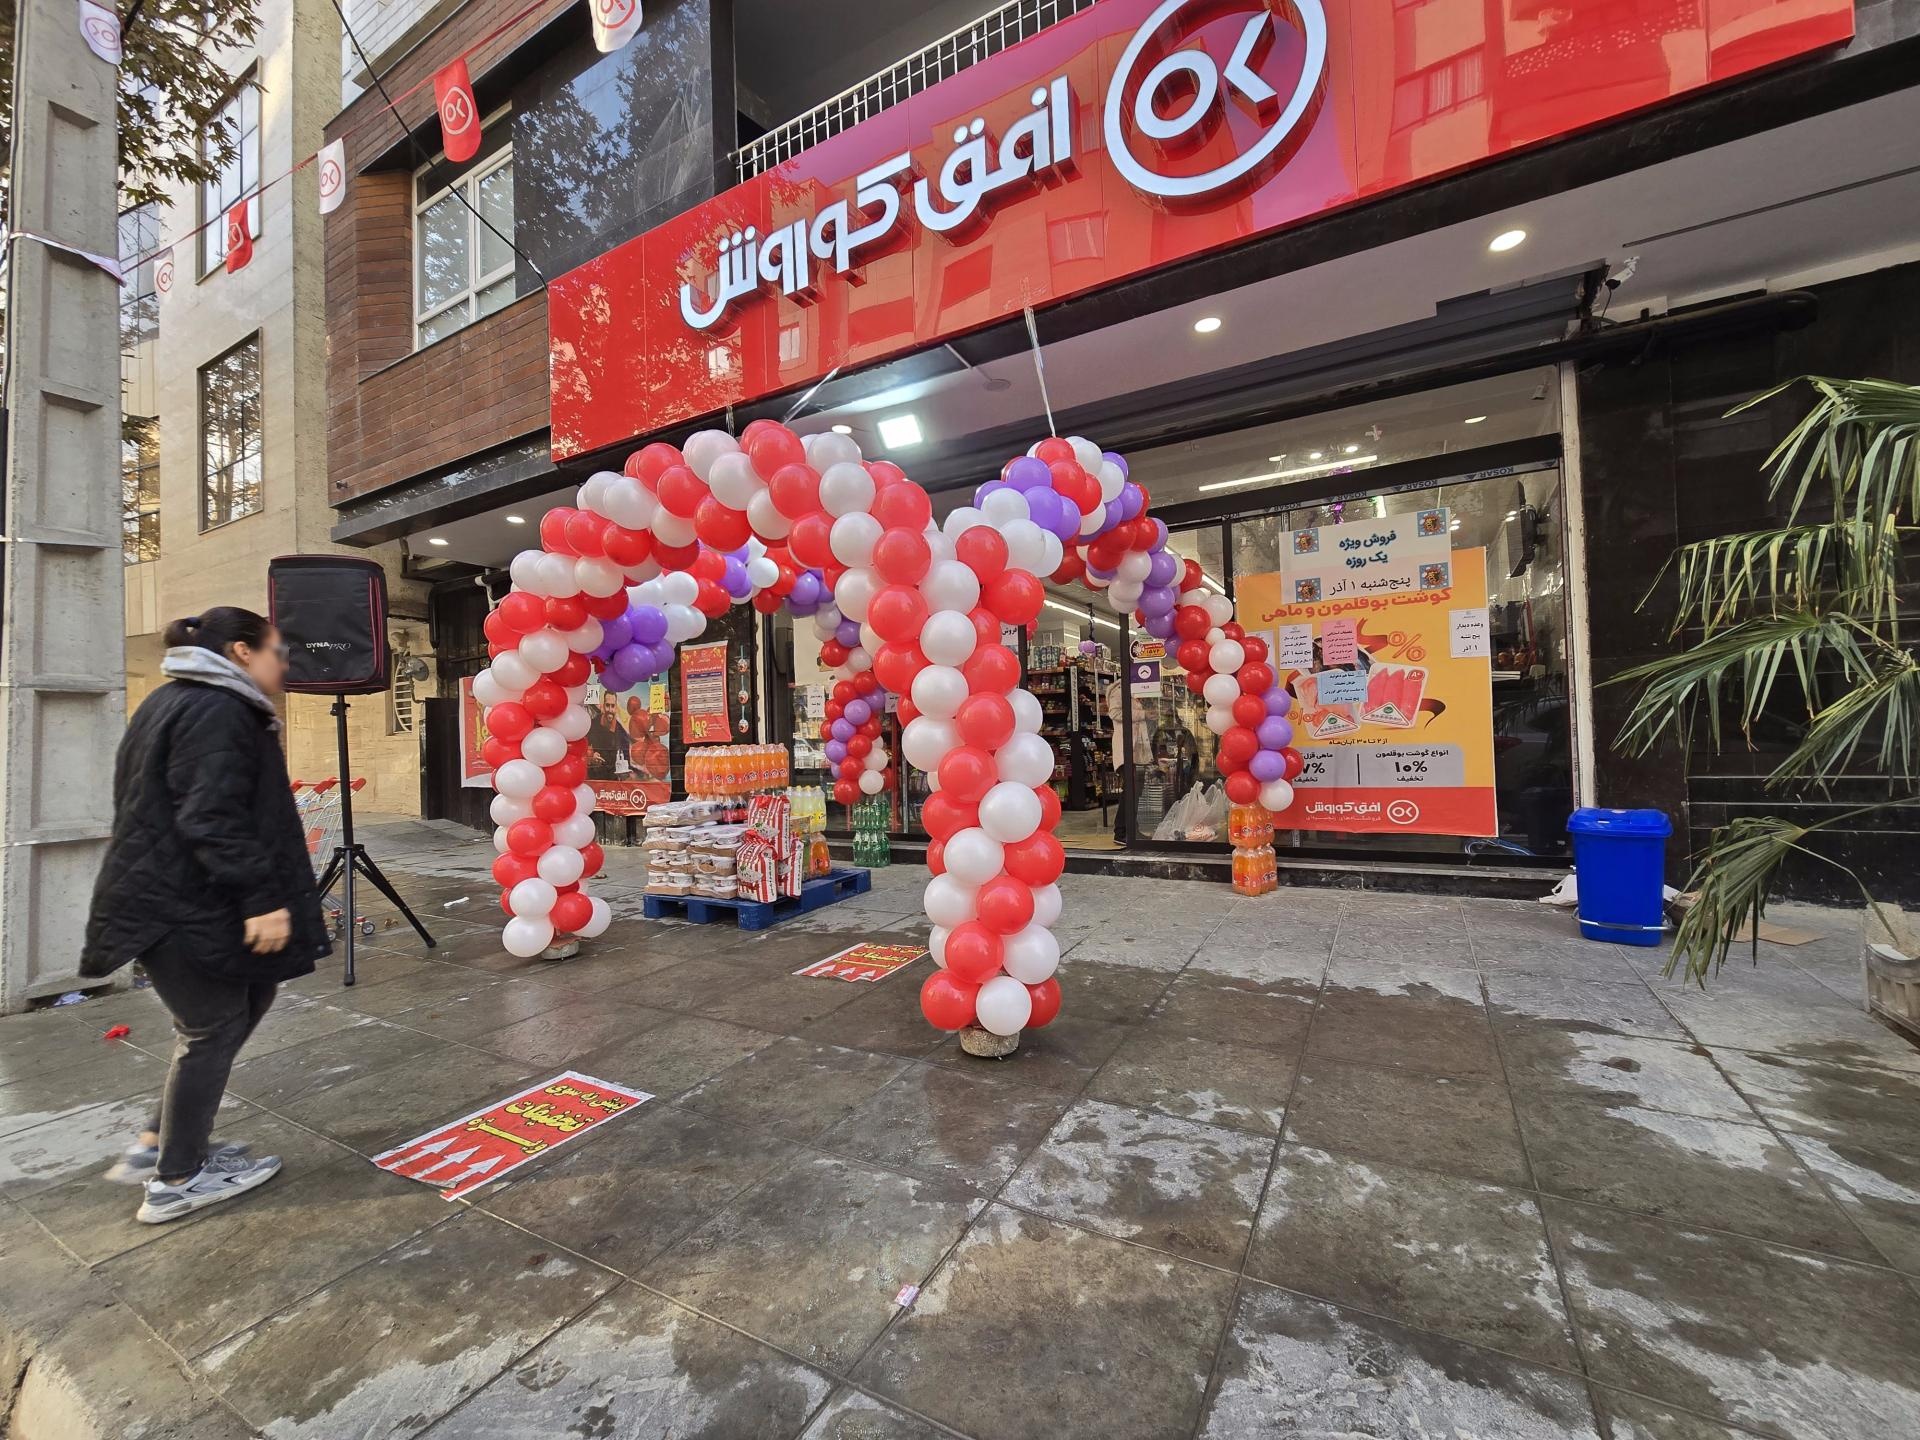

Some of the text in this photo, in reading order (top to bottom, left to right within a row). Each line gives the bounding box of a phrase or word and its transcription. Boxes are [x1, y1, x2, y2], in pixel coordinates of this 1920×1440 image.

[1134, 8, 1279, 142] OK
[680, 75, 1073, 331] افق کوروش
[1479, 466, 1514, 479] KOSAR
[1406, 479, 1438, 490] KOSAR
[1339, 530, 1397, 551] فروش ویژه
[1345, 551, 1388, 568] یک روزه
[1329, 578, 1347, 596] آذر
[1261, 604, 1303, 622] ماهی
[1305, 606, 1315, 618] و
[1317, 596, 1389, 617] بوقلمون
[1375, 749, 1449, 758] انواع گوشت بوقلمون
[614, 790, 628, 801] افق
[1305, 801, 1381, 814] افق کوروش
[544, 1084, 628, 1114] پیش به سوی
[504, 1100, 595, 1133] تخفیفات
